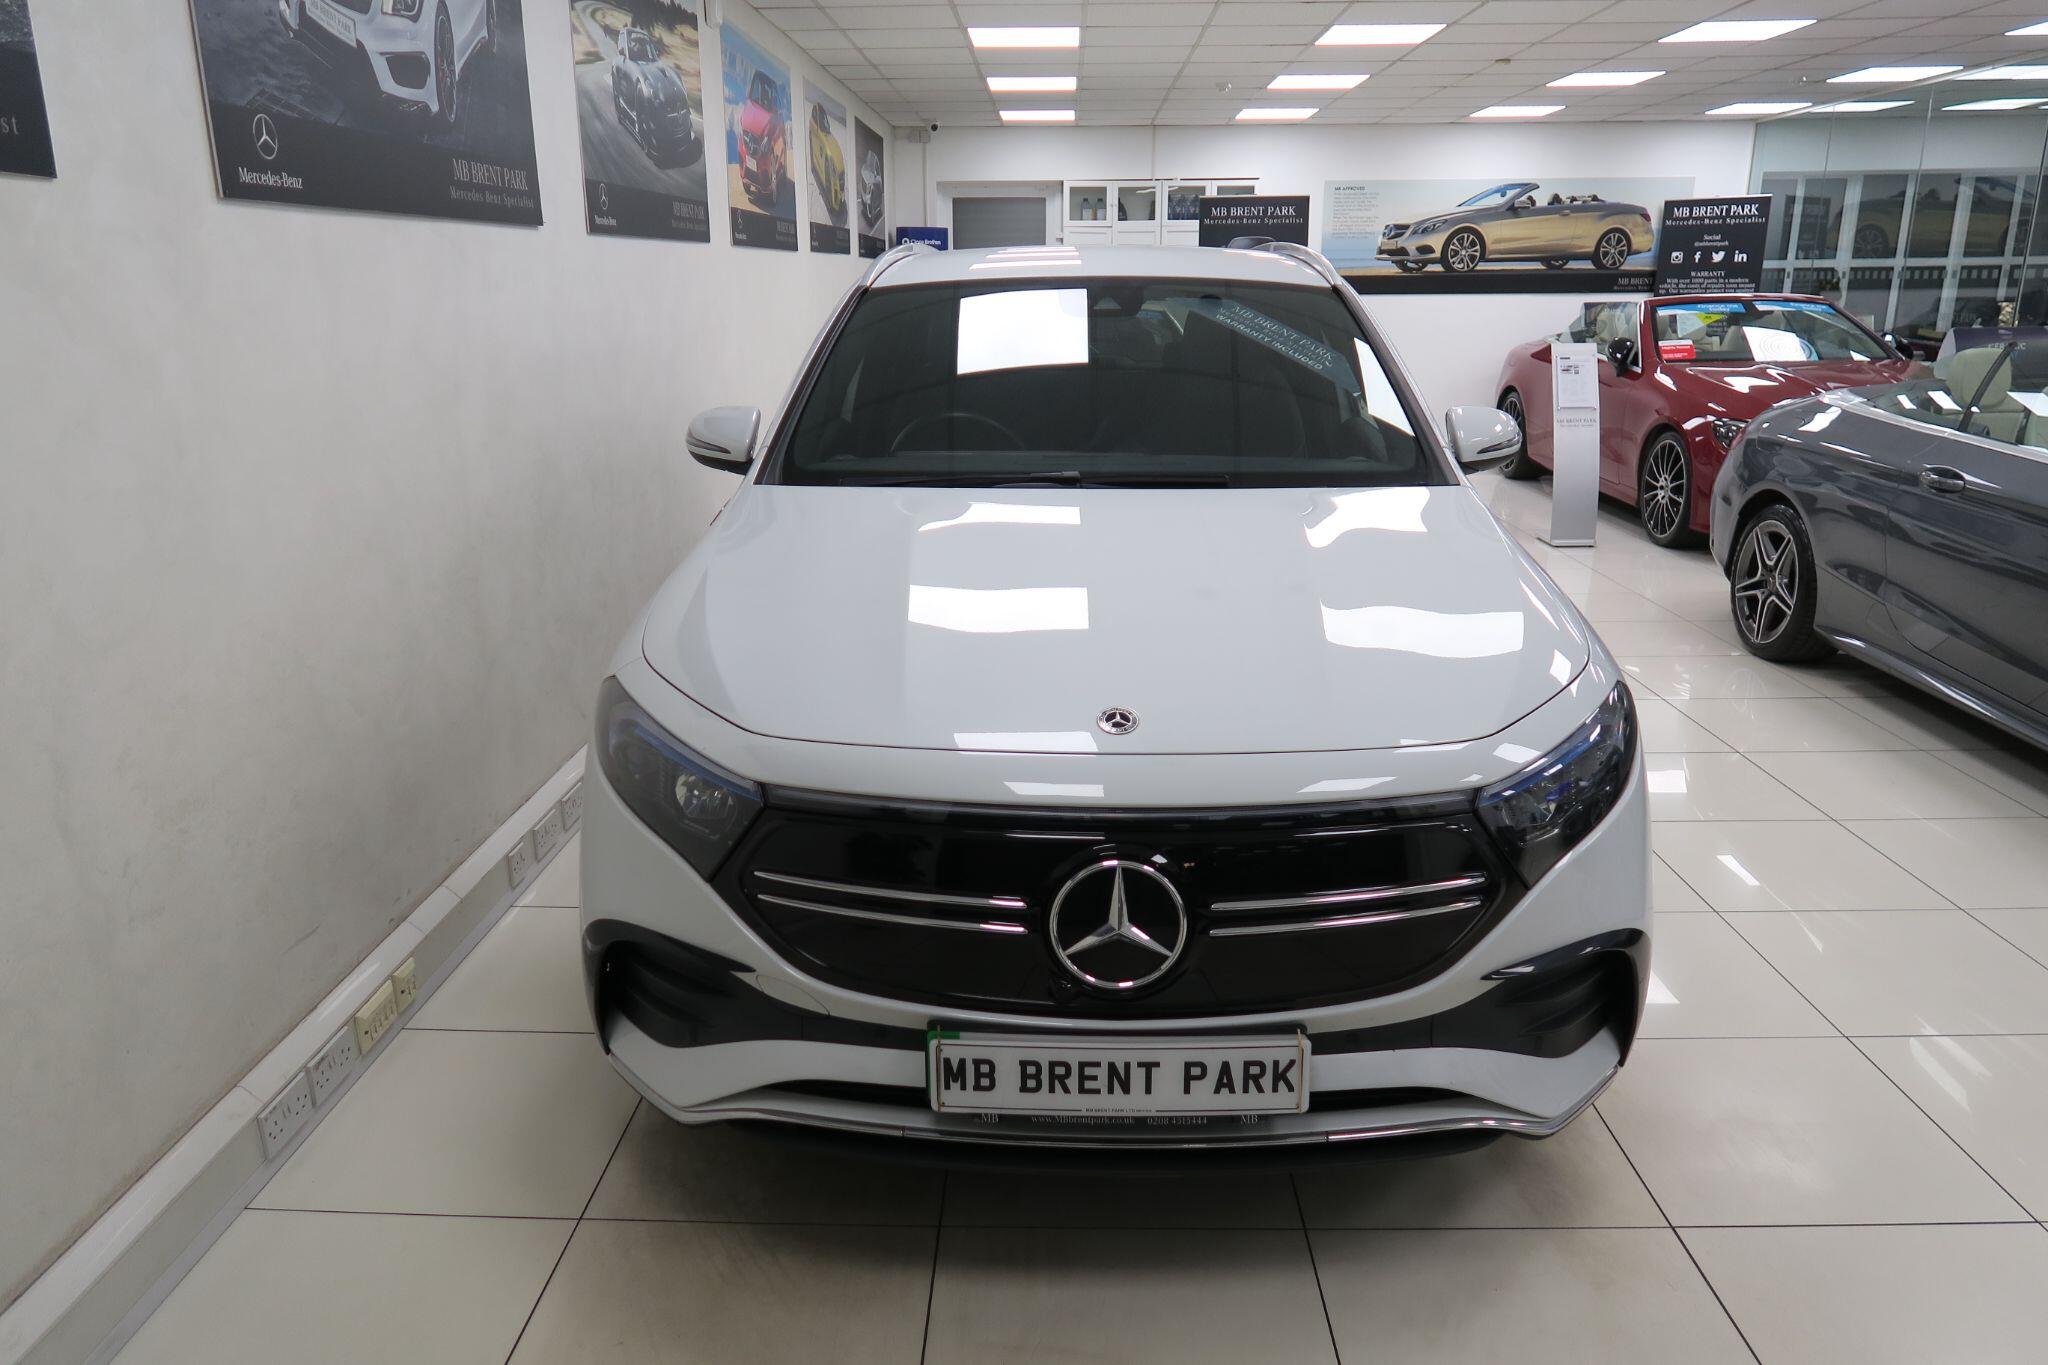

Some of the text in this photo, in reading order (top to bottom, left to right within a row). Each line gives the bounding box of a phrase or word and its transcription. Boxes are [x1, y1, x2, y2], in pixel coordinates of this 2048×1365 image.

[238, 166, 303, 189] Mercedes-Benz
[452, 158, 528, 190] MB BRENT PARK
[1211, 206, 1297, 217] MB BRENT PARK
[1673, 204, 1760, 218] MB BRENT PARK
[1264, 217, 1304, 225] Specialist
[1665, 217, 1766, 226] Mercedes-Benz Specialist
[1216, 313, 1271, 342] WARRANTY
[1271, 340, 1324, 371] INCLUDED
[1232, 306, 1333, 361] MB BRENT PARK
[943, 1057, 1297, 1095] MB BRENT PARK
[981, 1113, 999, 1123] MB
[1240, 1113, 1259, 1123] MB
